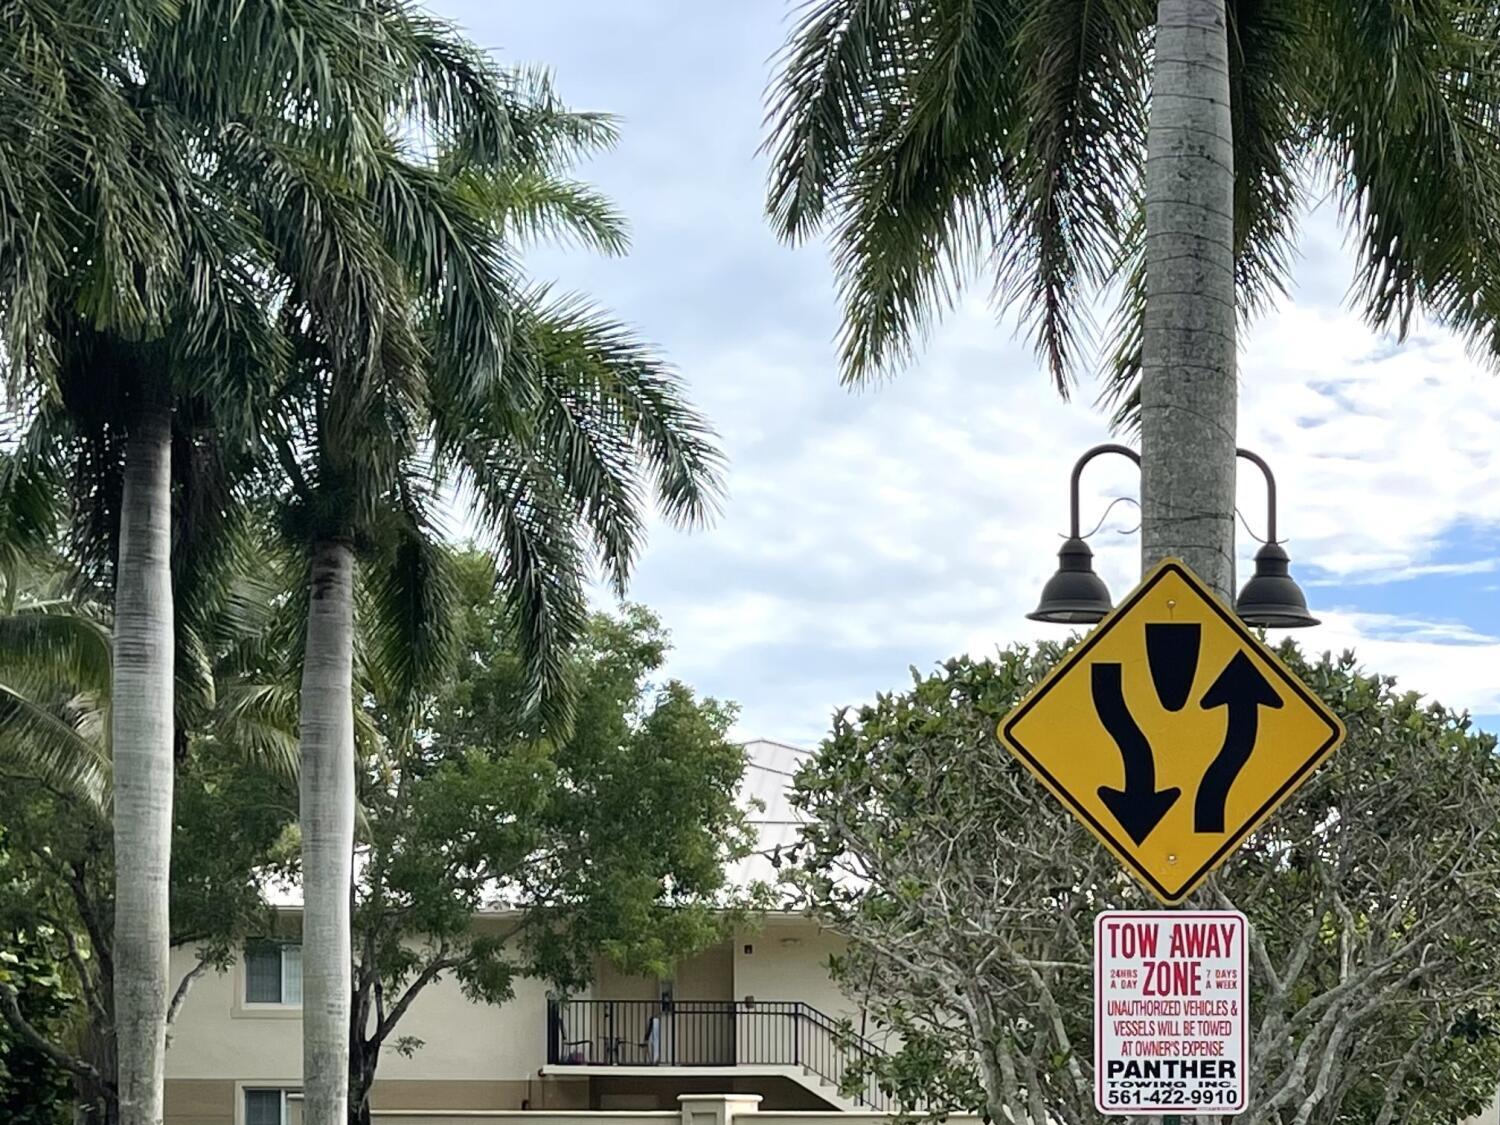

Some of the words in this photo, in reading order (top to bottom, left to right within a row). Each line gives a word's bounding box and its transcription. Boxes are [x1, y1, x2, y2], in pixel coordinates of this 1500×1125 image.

[1107, 923, 1159, 958] TOW
[1169, 923, 1236, 958] AWAY
[1110, 969, 1138, 978] 24HRS
[1142, 961, 1202, 996] ZONE
[1206, 969, 1211, 979] 7
[1215, 969, 1237, 979] DAYS
[1110, 980, 1117, 989] A
[1121, 980, 1137, 989] DAY
[1206, 980, 1211, 989] A
[1215, 980, 1237, 989] WEEK
[1107, 1000, 1181, 1016] UNAUTHORIZED
[1183, 1000, 1228, 1017] VEHICLES
[1230, 1001, 1238, 1016] &
[1113, 1020, 1155, 1036] VESSELS
[1158, 1020, 1181, 1036] WILL
[1183, 1020, 1195, 1036] BE
[1197, 1020, 1232, 1036] TOWED
[1121, 1041, 1134, 1057] AT
[1135, 1041, 1180, 1057] OWNER'S
[1182, 1041, 1224, 1057] EXPENSE
[1107, 1060, 1236, 1079] PANTHER
[1108, 1089, 1237, 1105] 561-422-9910
